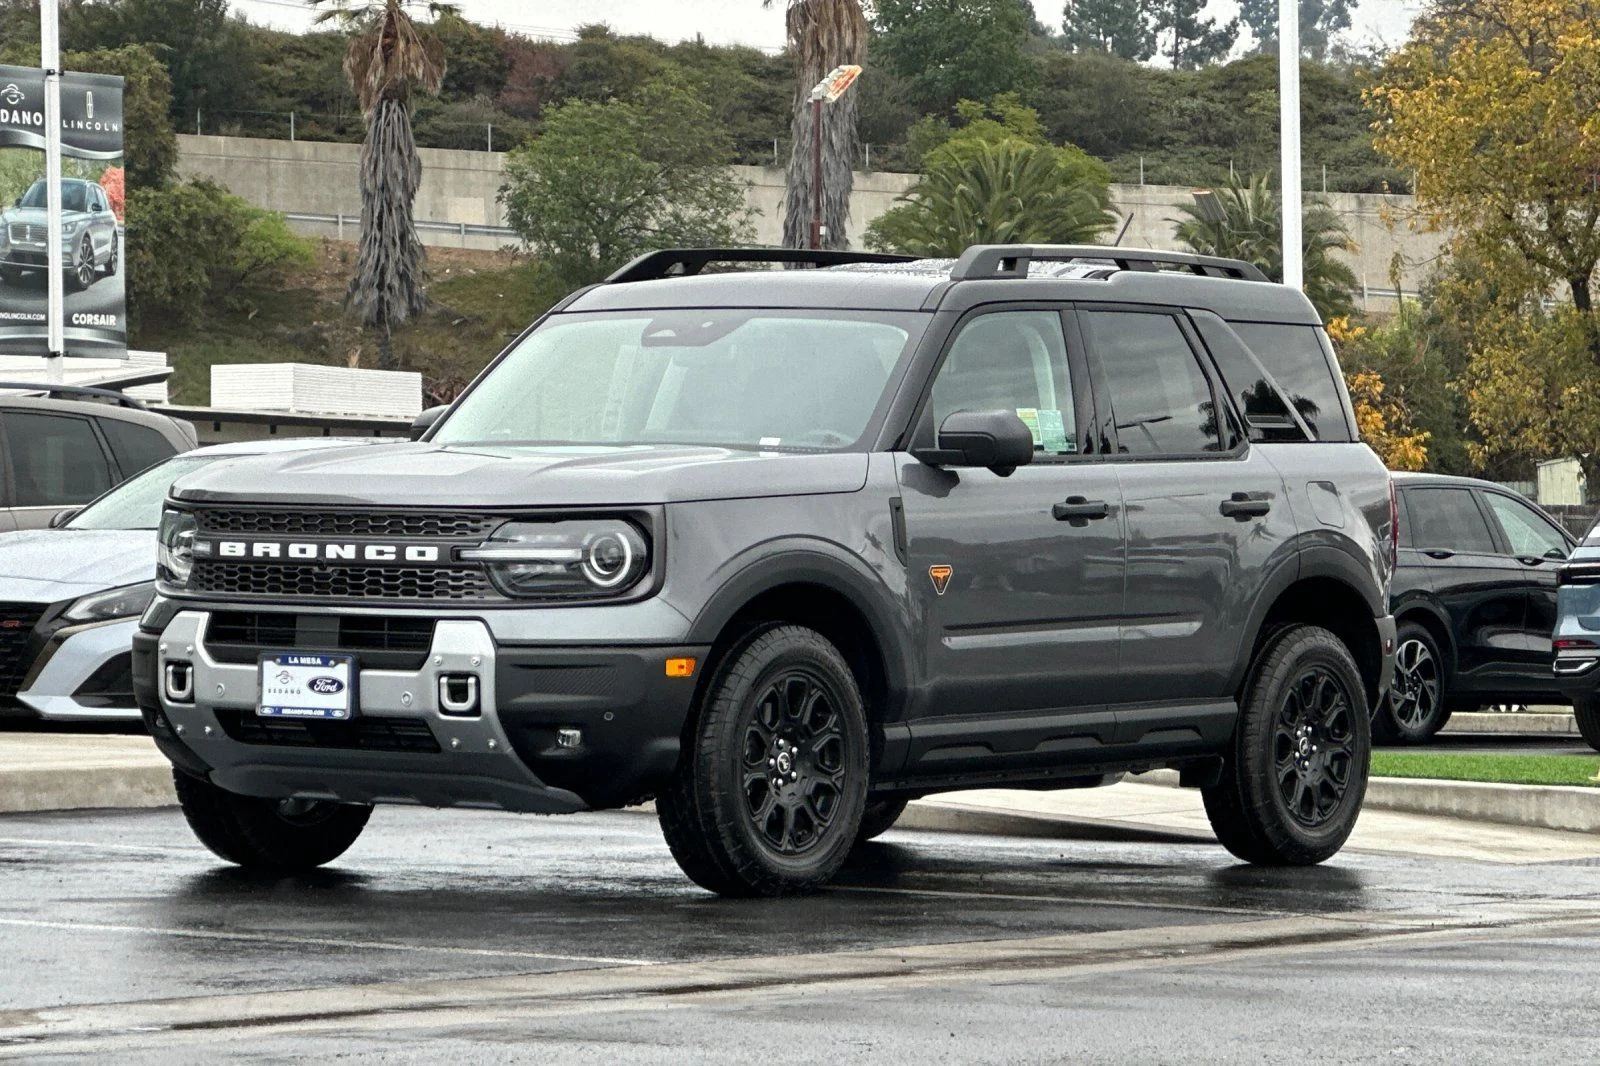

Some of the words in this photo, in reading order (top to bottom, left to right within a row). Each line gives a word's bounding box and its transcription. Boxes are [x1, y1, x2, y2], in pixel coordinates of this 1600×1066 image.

[62, 120, 119, 131] LINCOLN
[72, 313, 117, 325] CORSAIR
[219, 541, 439, 561] BRONCO
[300, 657, 322, 665] MESA
[313, 678, 338, 692] Ford
